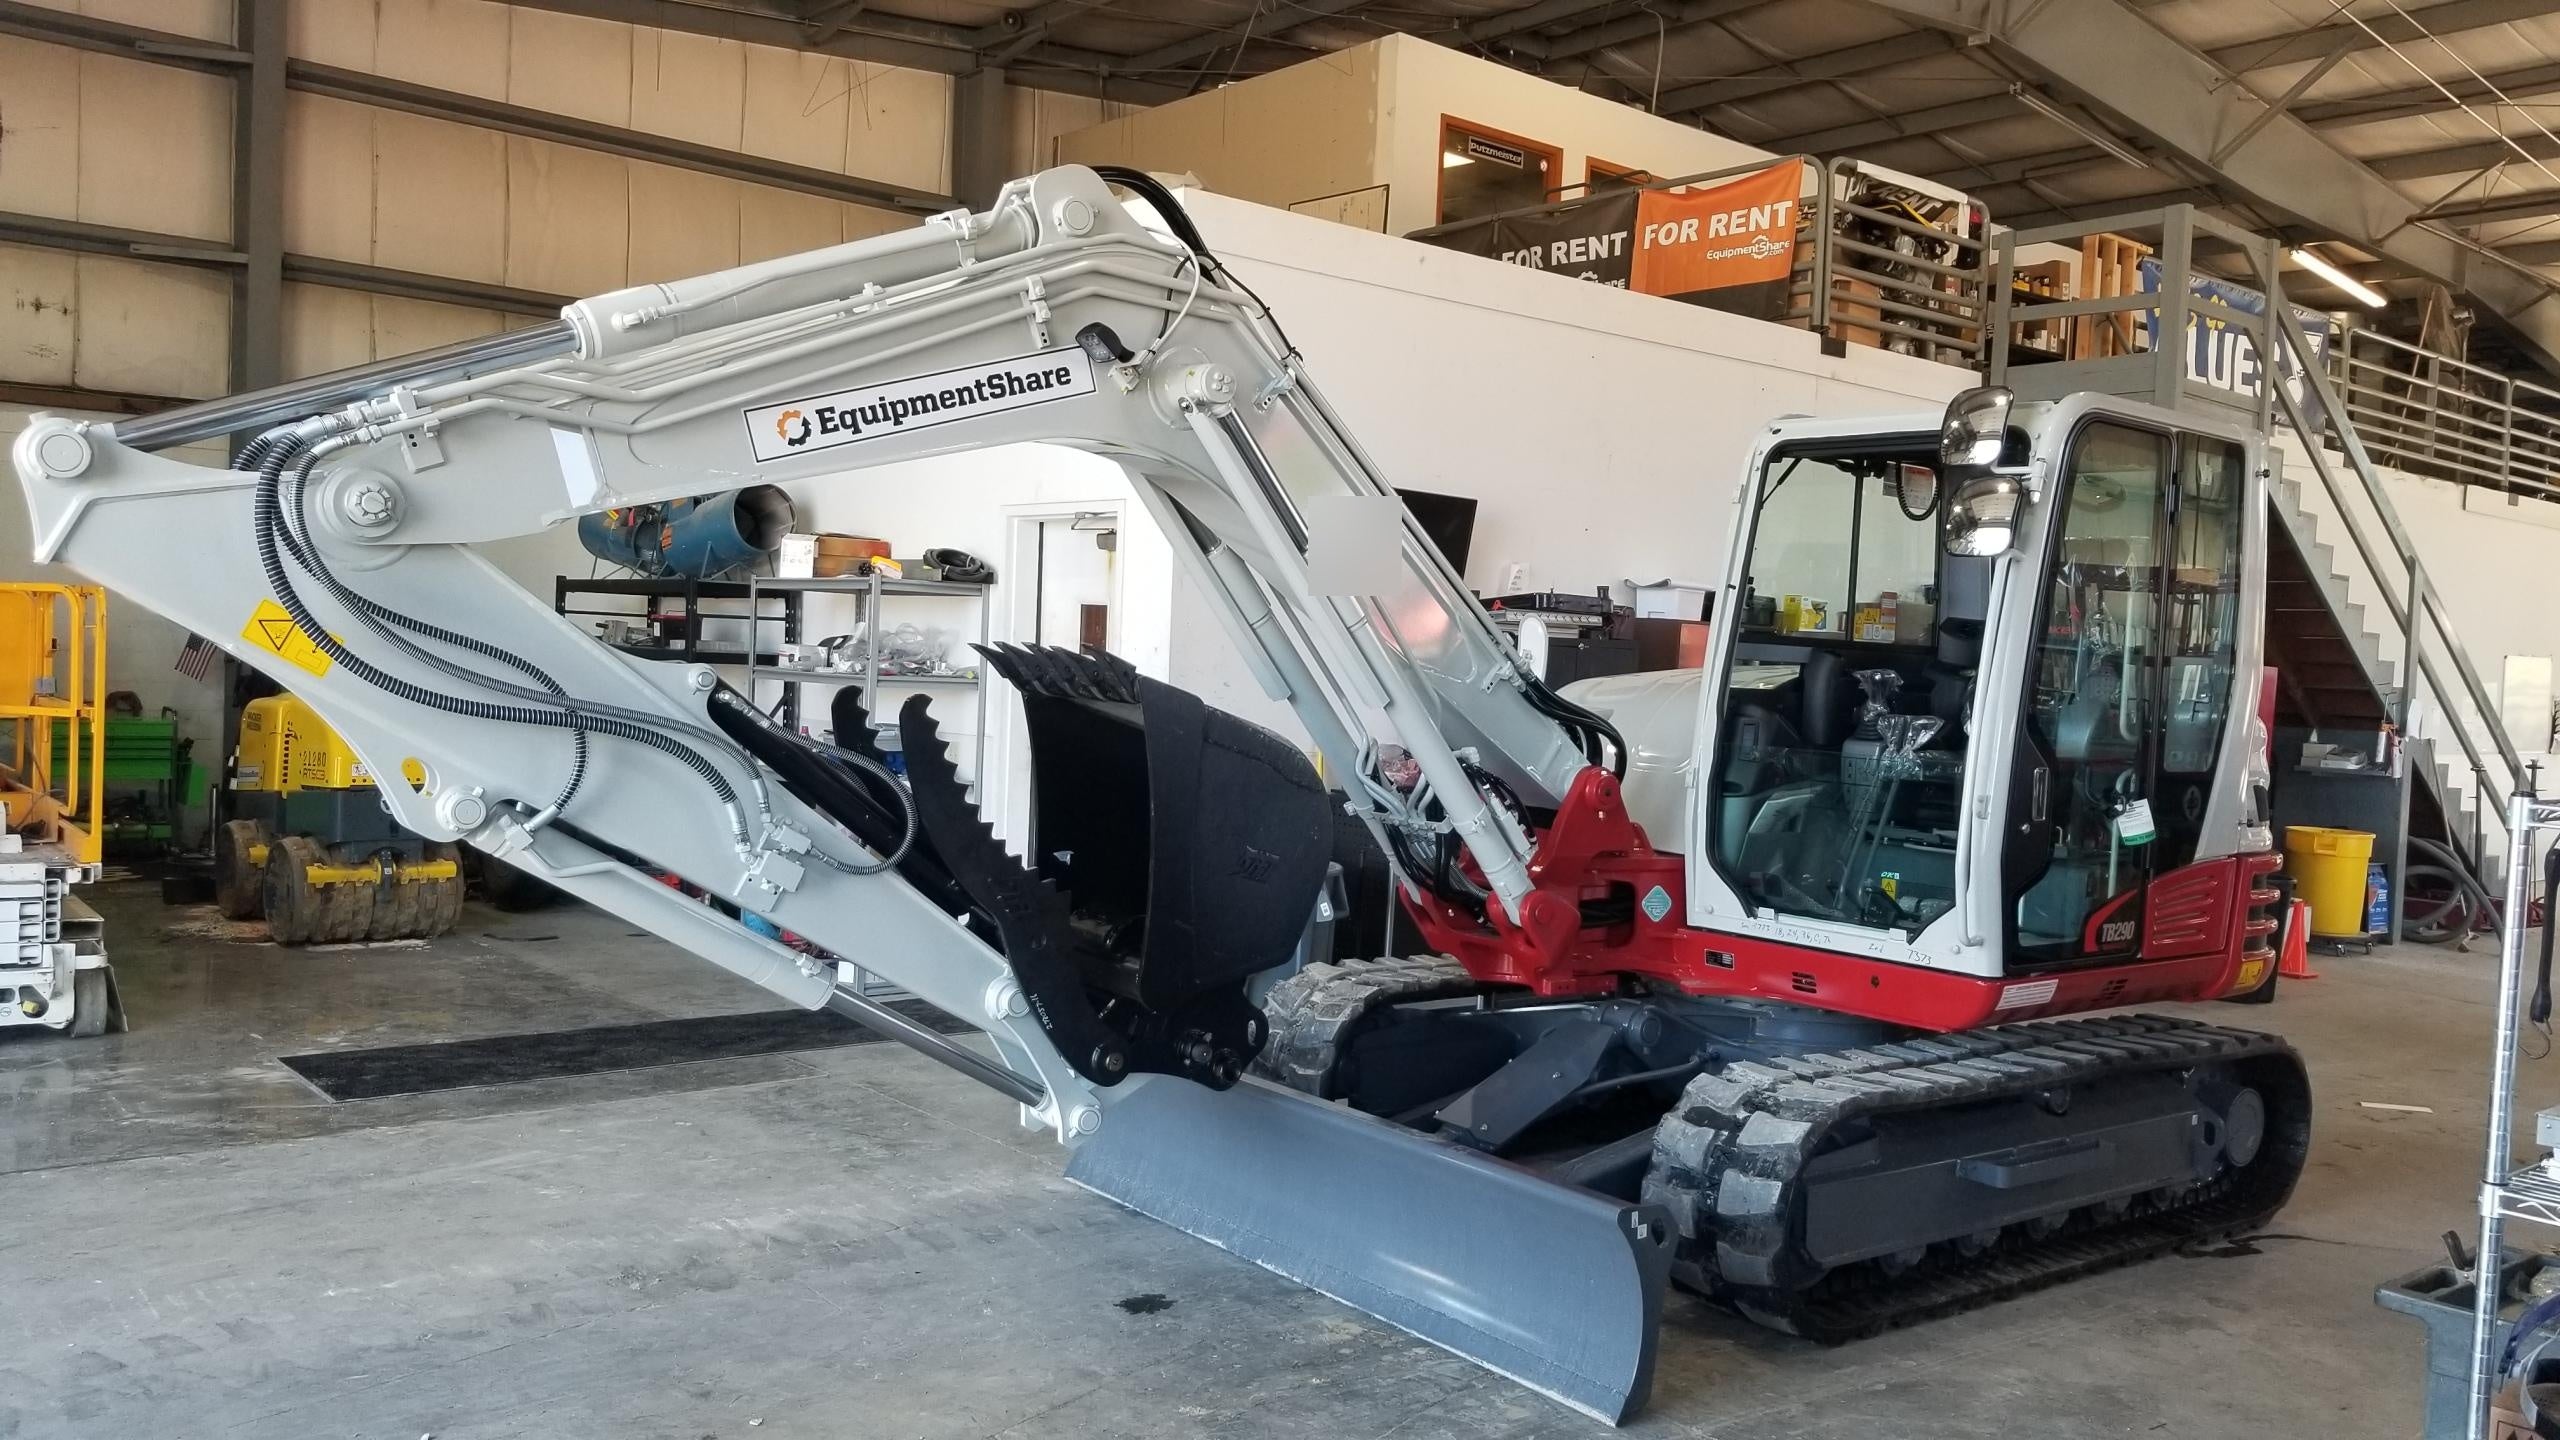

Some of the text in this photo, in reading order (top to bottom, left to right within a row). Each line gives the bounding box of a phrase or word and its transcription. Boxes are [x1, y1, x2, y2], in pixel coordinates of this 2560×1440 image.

[1643, 200, 1793, 249] FOR RENT
[1551, 231, 1628, 266] RENT
[1706, 238, 1791, 260] EquipmentShare
[815, 365, 1072, 435] EquipmentShare
[303, 751, 327, 767] 21280
[2101, 920, 2135, 943] TB290
